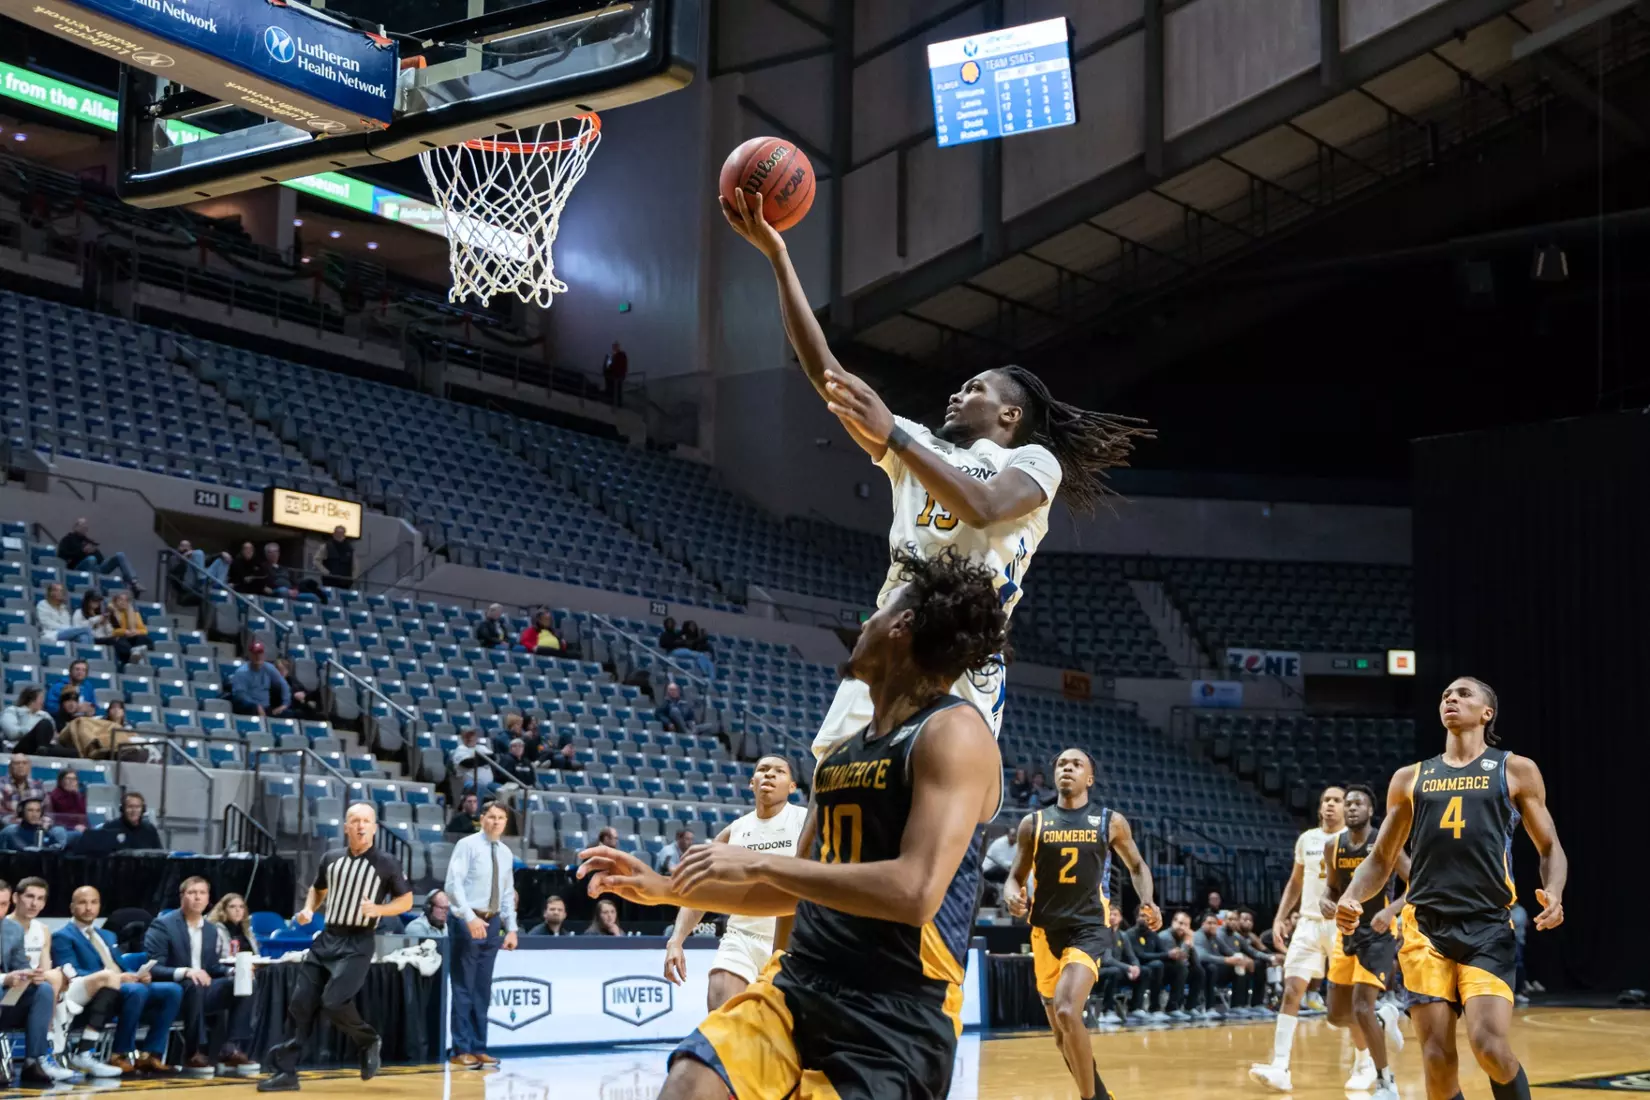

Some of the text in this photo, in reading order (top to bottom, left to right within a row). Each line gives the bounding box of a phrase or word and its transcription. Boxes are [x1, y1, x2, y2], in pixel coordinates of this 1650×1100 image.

[162, 0, 218, 34] Network
[297, 37, 360, 73] Lutheran
[6, 72, 46, 101] from
[49, 86, 77, 110] the
[298, 55, 387, 99] Health Network
[743, 145, 789, 196] Wilson
[774, 167, 806, 209] NCAA
[197, 491, 216, 506] 214
[301, 498, 325, 514] Burt
[815, 758, 892, 794] COMMERCE
[1422, 775, 1490, 793] COMMERCE
[820, 803, 863, 864] 10
[1439, 796, 1466, 839] 4
[1043, 829, 1098, 843] COMMERCE
[1059, 847, 1079, 884] 2
[490, 988, 541, 1006] NVETS
[612, 987, 664, 1004] INVETS
